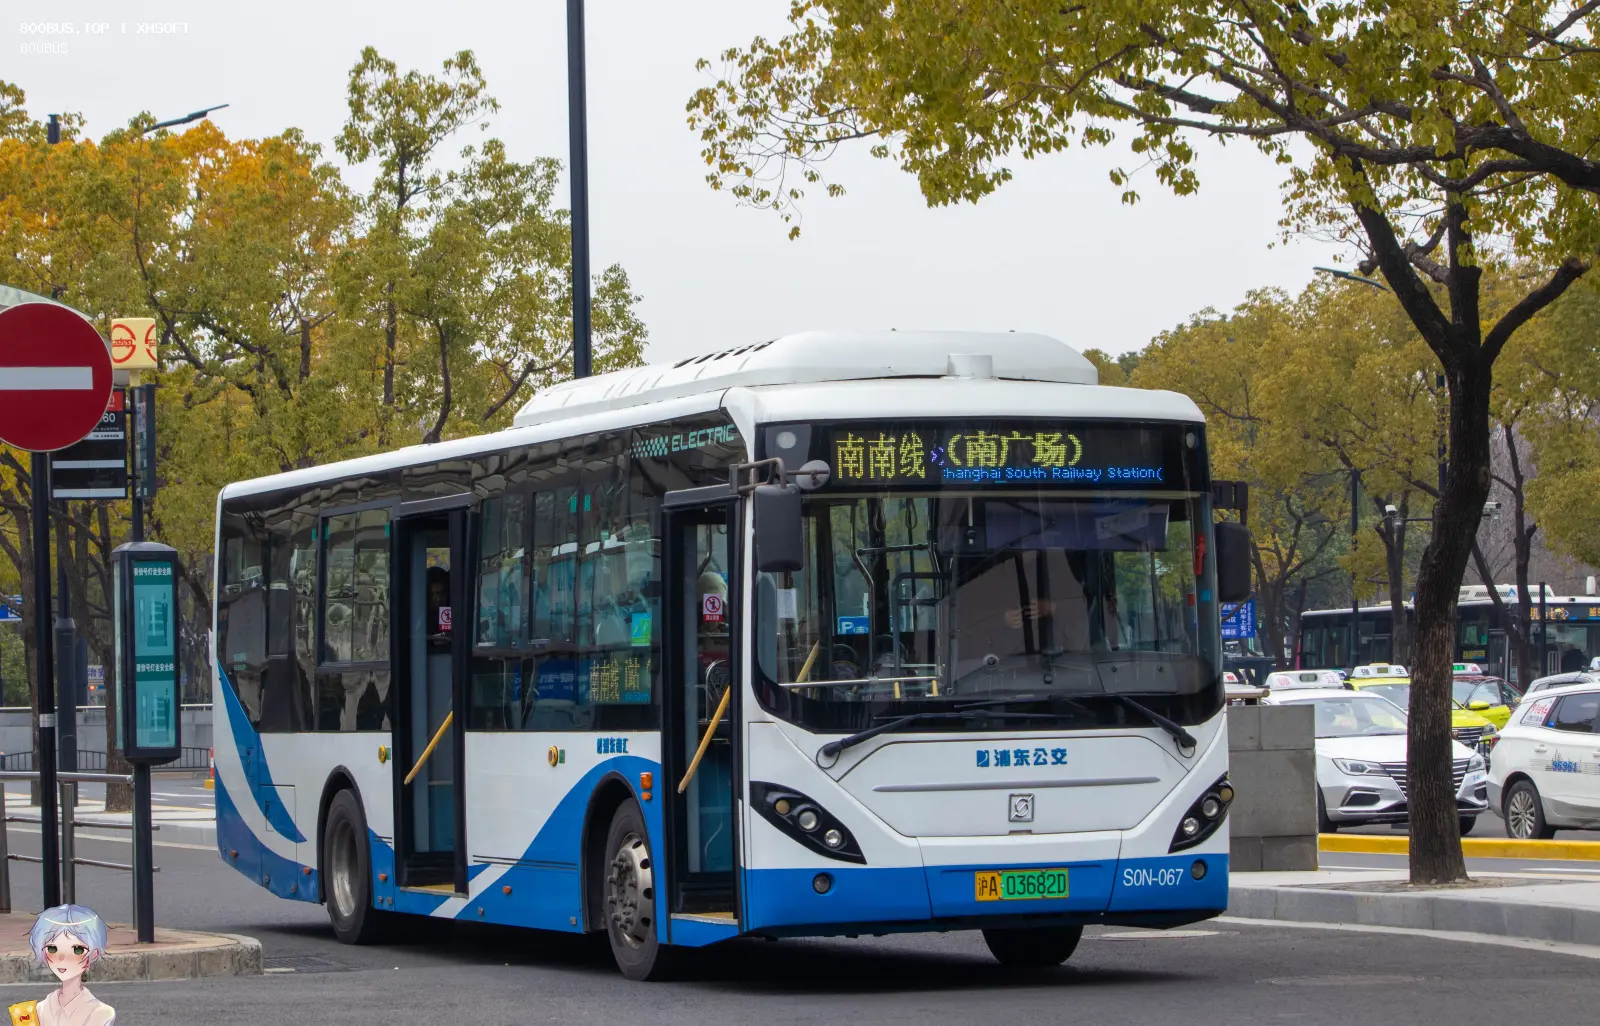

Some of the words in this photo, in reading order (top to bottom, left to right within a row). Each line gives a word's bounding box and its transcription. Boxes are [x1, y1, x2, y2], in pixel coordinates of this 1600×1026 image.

[671, 423, 735, 452] ELECTRIC
[947, 430, 1083, 468] (南广场)
[836, 432, 925, 479] 南南线
[943, 467, 1001, 482] hanghai
[1005, 466, 1046, 479] South
[1052, 467, 1102, 482] Railway
[994, 748, 1068, 767] 浦东公交
[1552, 760, 1578, 773] 96961
[1005, 872, 1067, 896] 03682D
